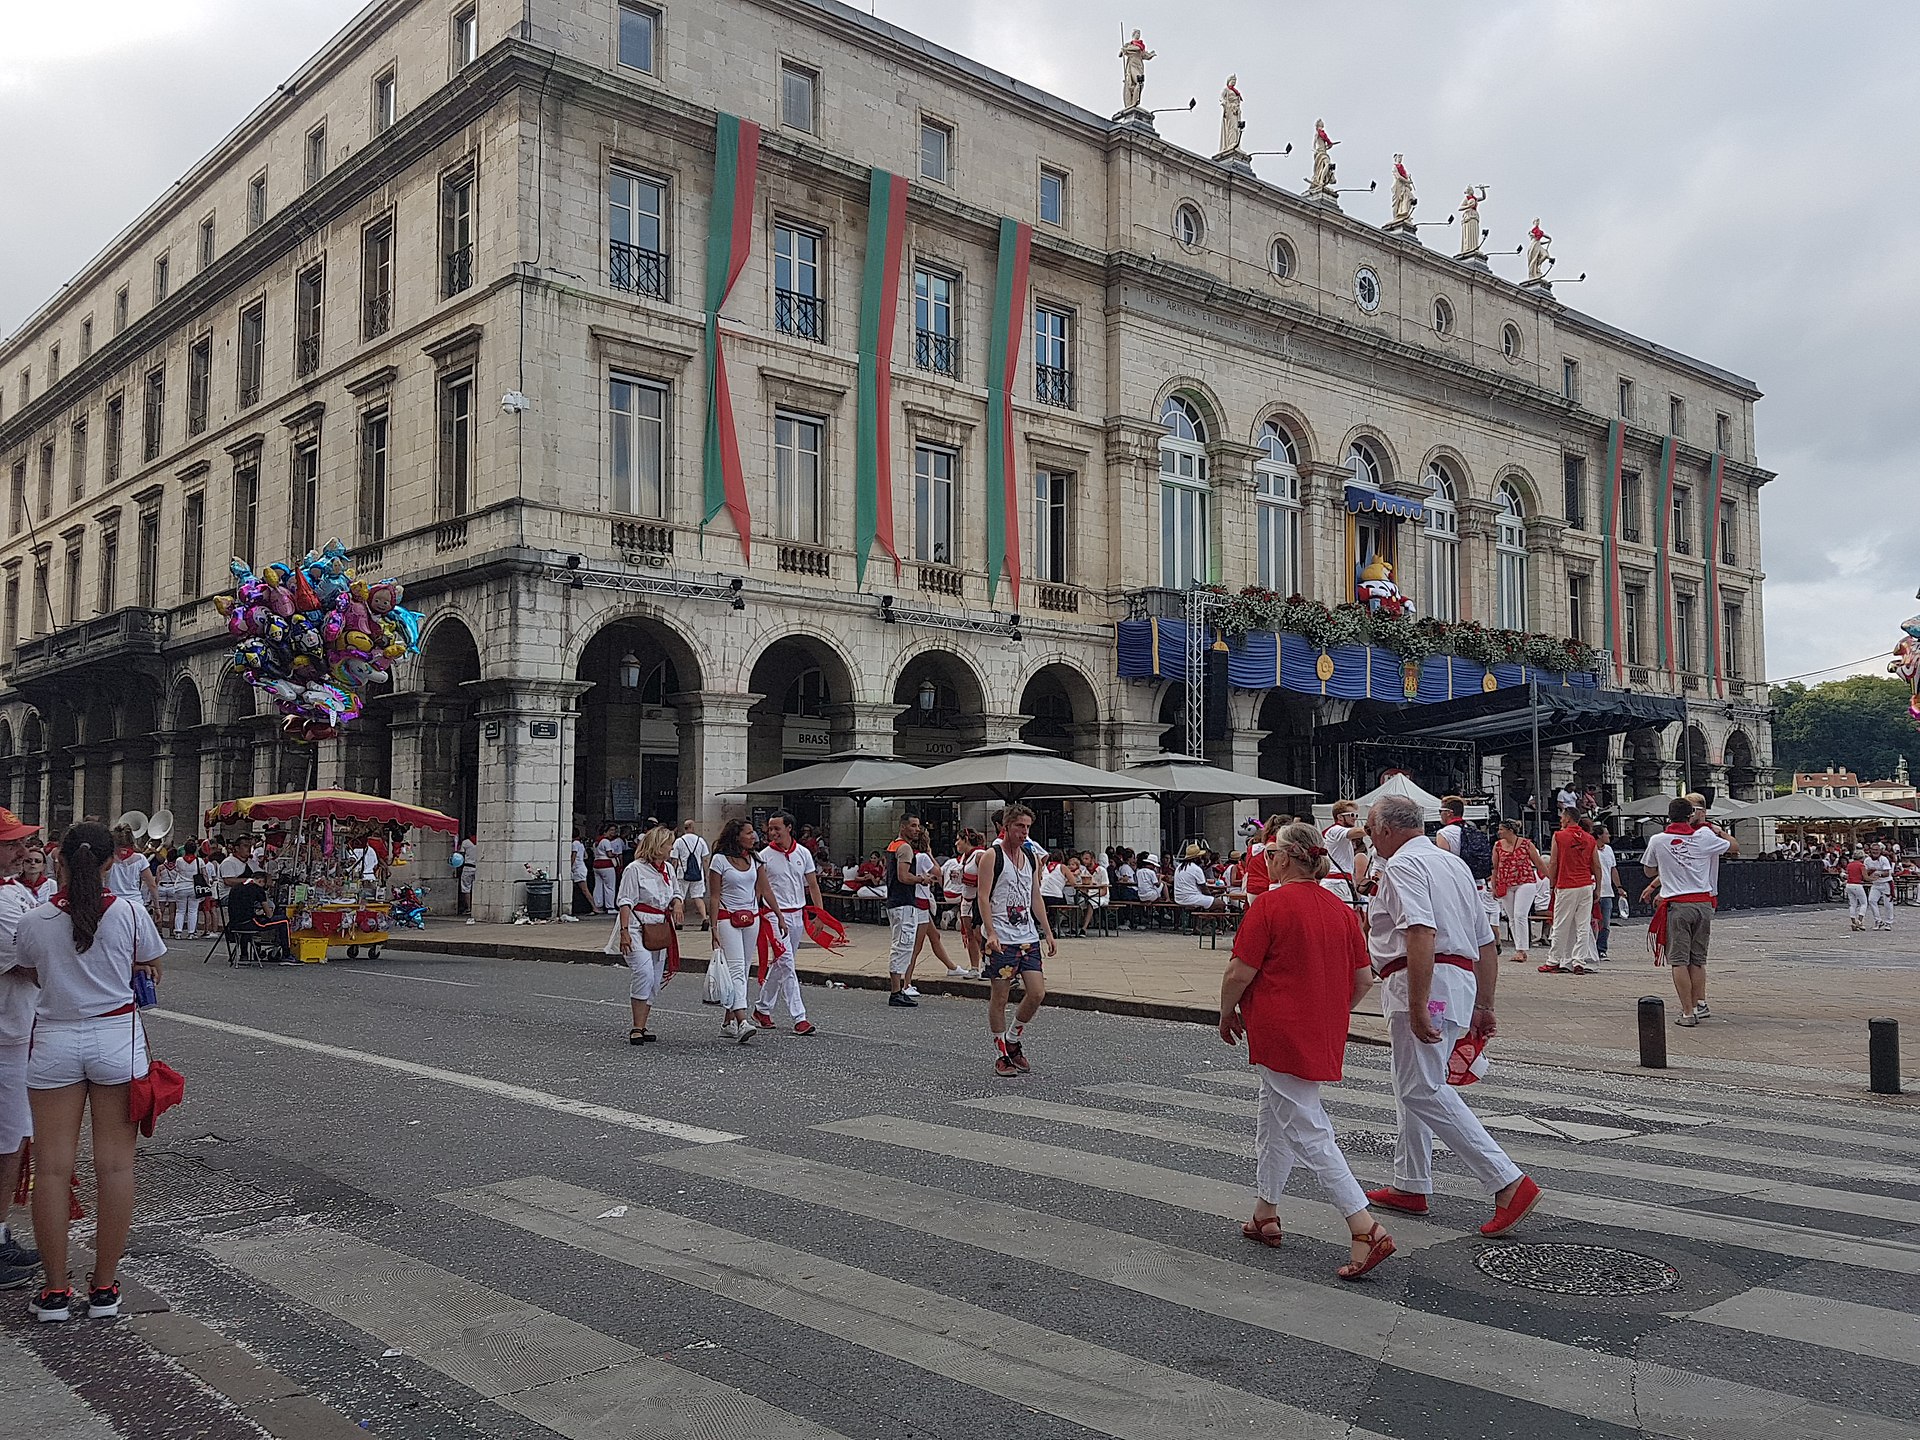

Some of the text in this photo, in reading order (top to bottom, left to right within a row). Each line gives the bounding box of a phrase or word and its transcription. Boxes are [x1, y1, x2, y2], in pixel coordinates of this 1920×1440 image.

[1145, 293, 1160, 305] LES
[1202, 312, 1211, 322] ET
[1253, 338, 1268, 348] ONT
[926, 743, 953, 753] LOTO
